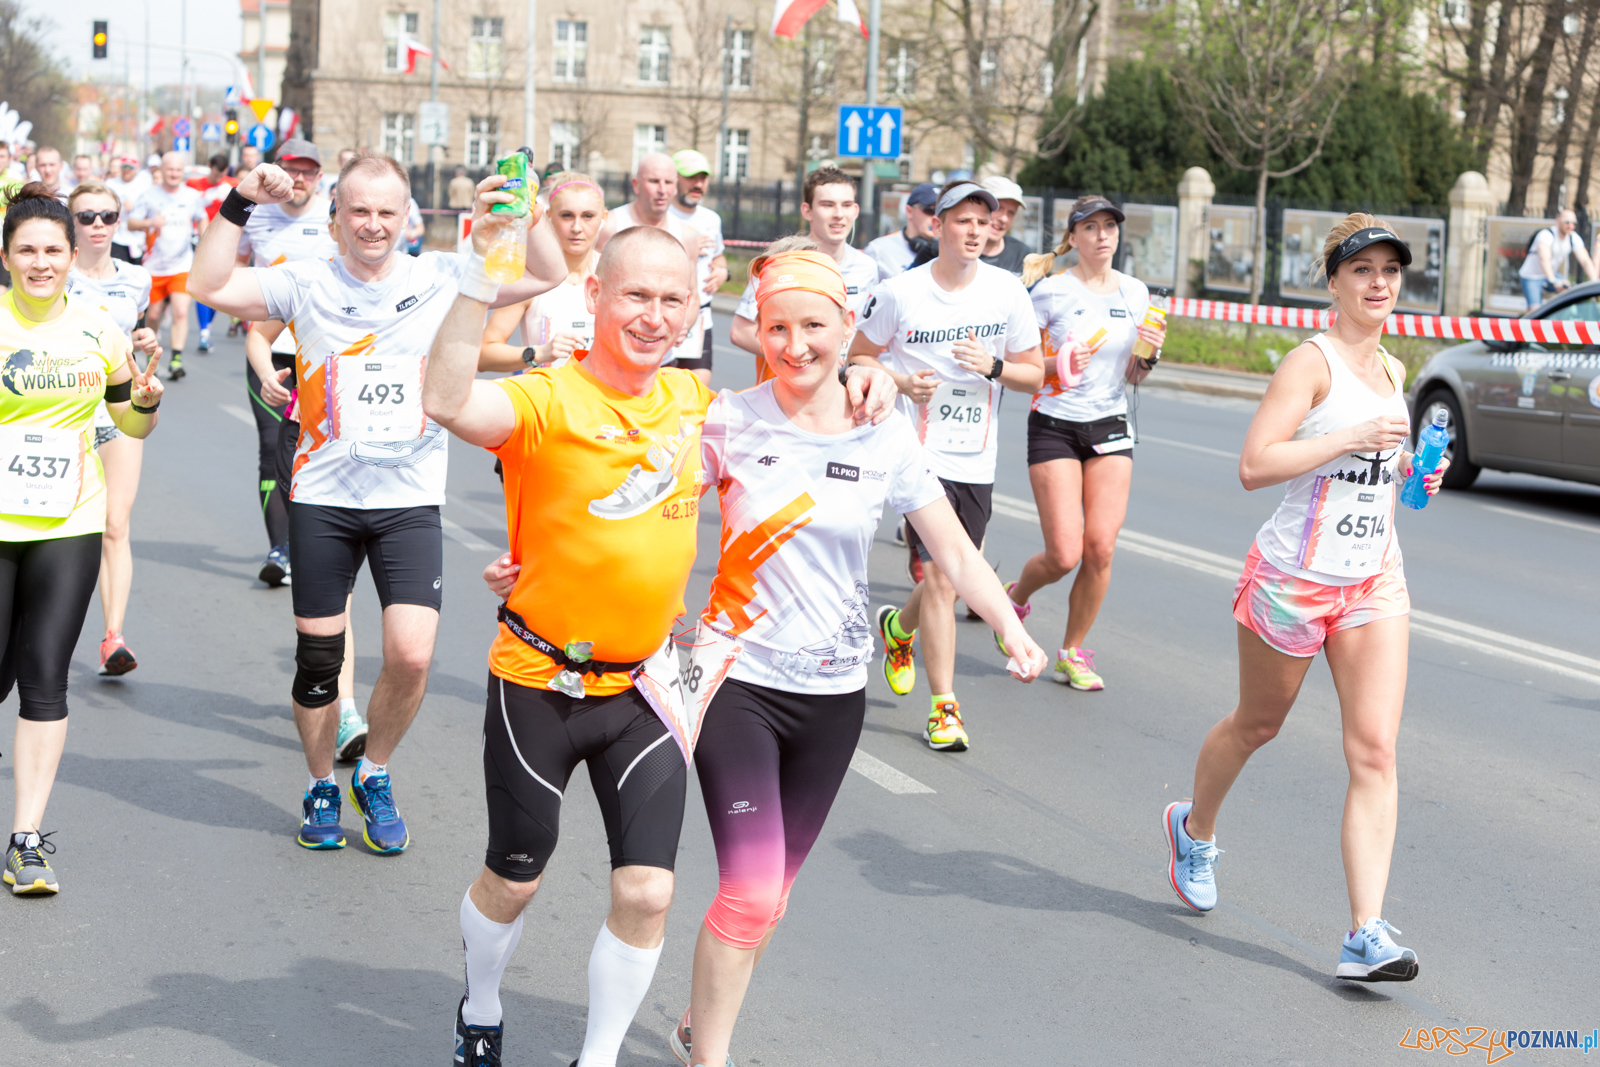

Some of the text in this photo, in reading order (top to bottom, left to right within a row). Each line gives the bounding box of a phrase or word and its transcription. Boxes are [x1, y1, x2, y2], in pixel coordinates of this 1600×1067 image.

[906, 322, 1007, 344] BRIDGESTONE
[22, 371, 102, 390] WORLD RUN
[358, 383, 405, 405] 493
[370, 409, 393, 417] Robert
[940, 404, 982, 423] 9418
[8, 454, 70, 479] 4337
[757, 455, 780, 467] 4F
[26, 482, 52, 490] Urszula
[1336, 514, 1385, 538] 6514
